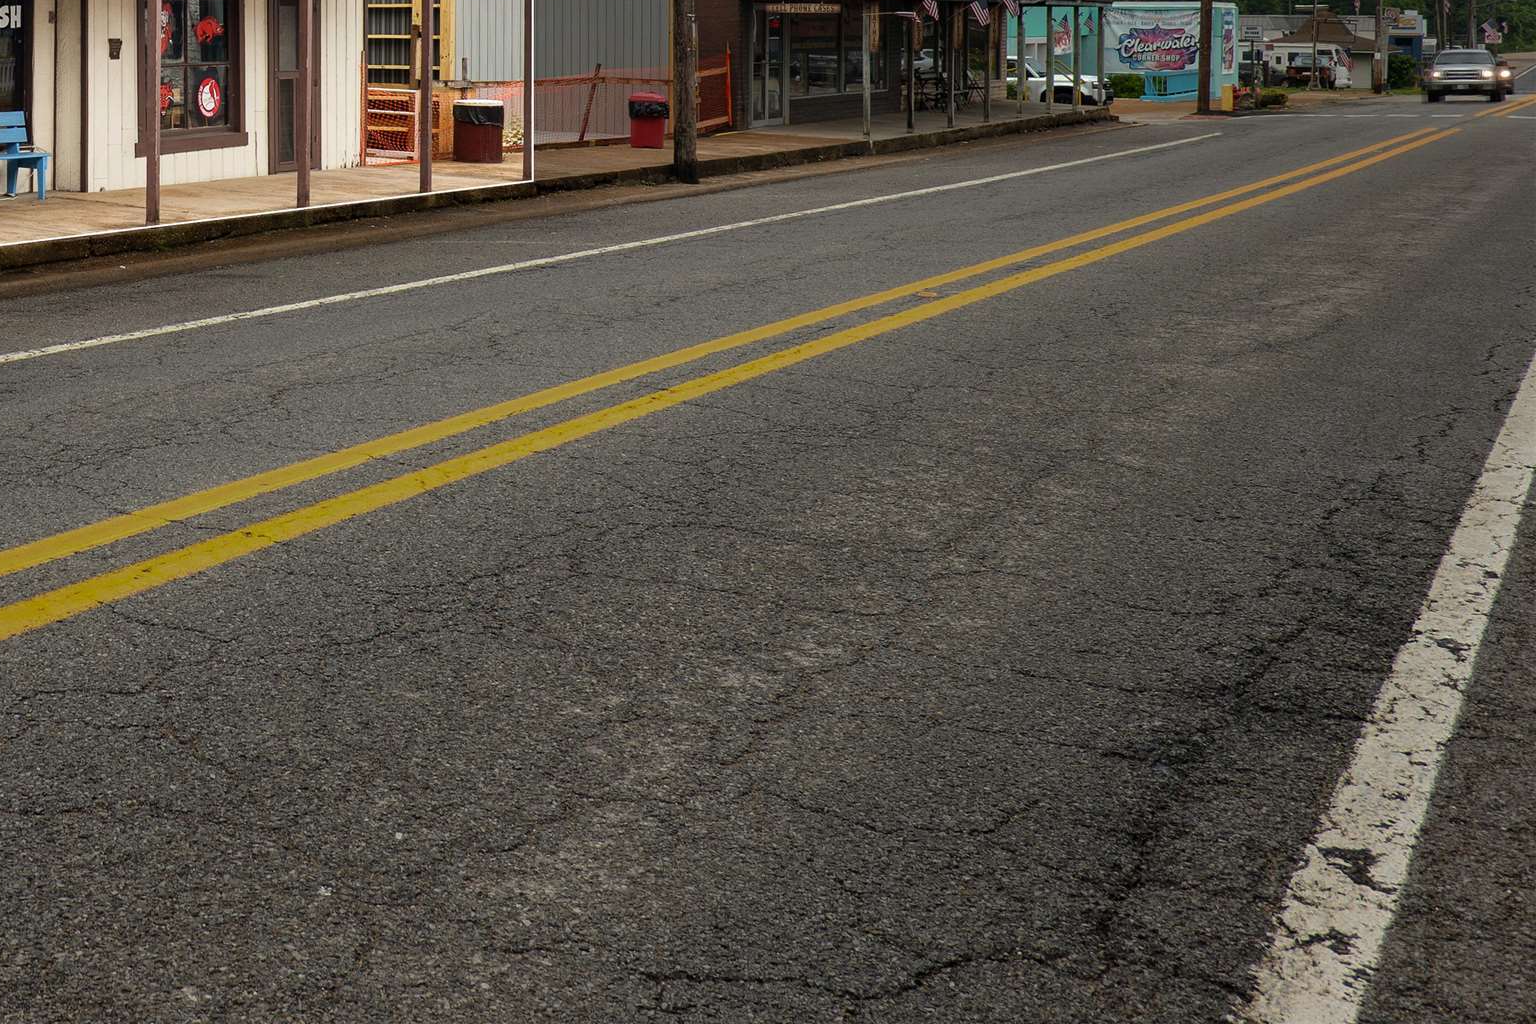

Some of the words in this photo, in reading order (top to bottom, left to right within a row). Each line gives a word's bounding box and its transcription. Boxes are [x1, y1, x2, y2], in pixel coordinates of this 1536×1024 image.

[1116, 34, 1200, 57] Clearwater
[1133, 54, 1160, 62] CORNER
[1161, 54, 1180, 62] SHOP
